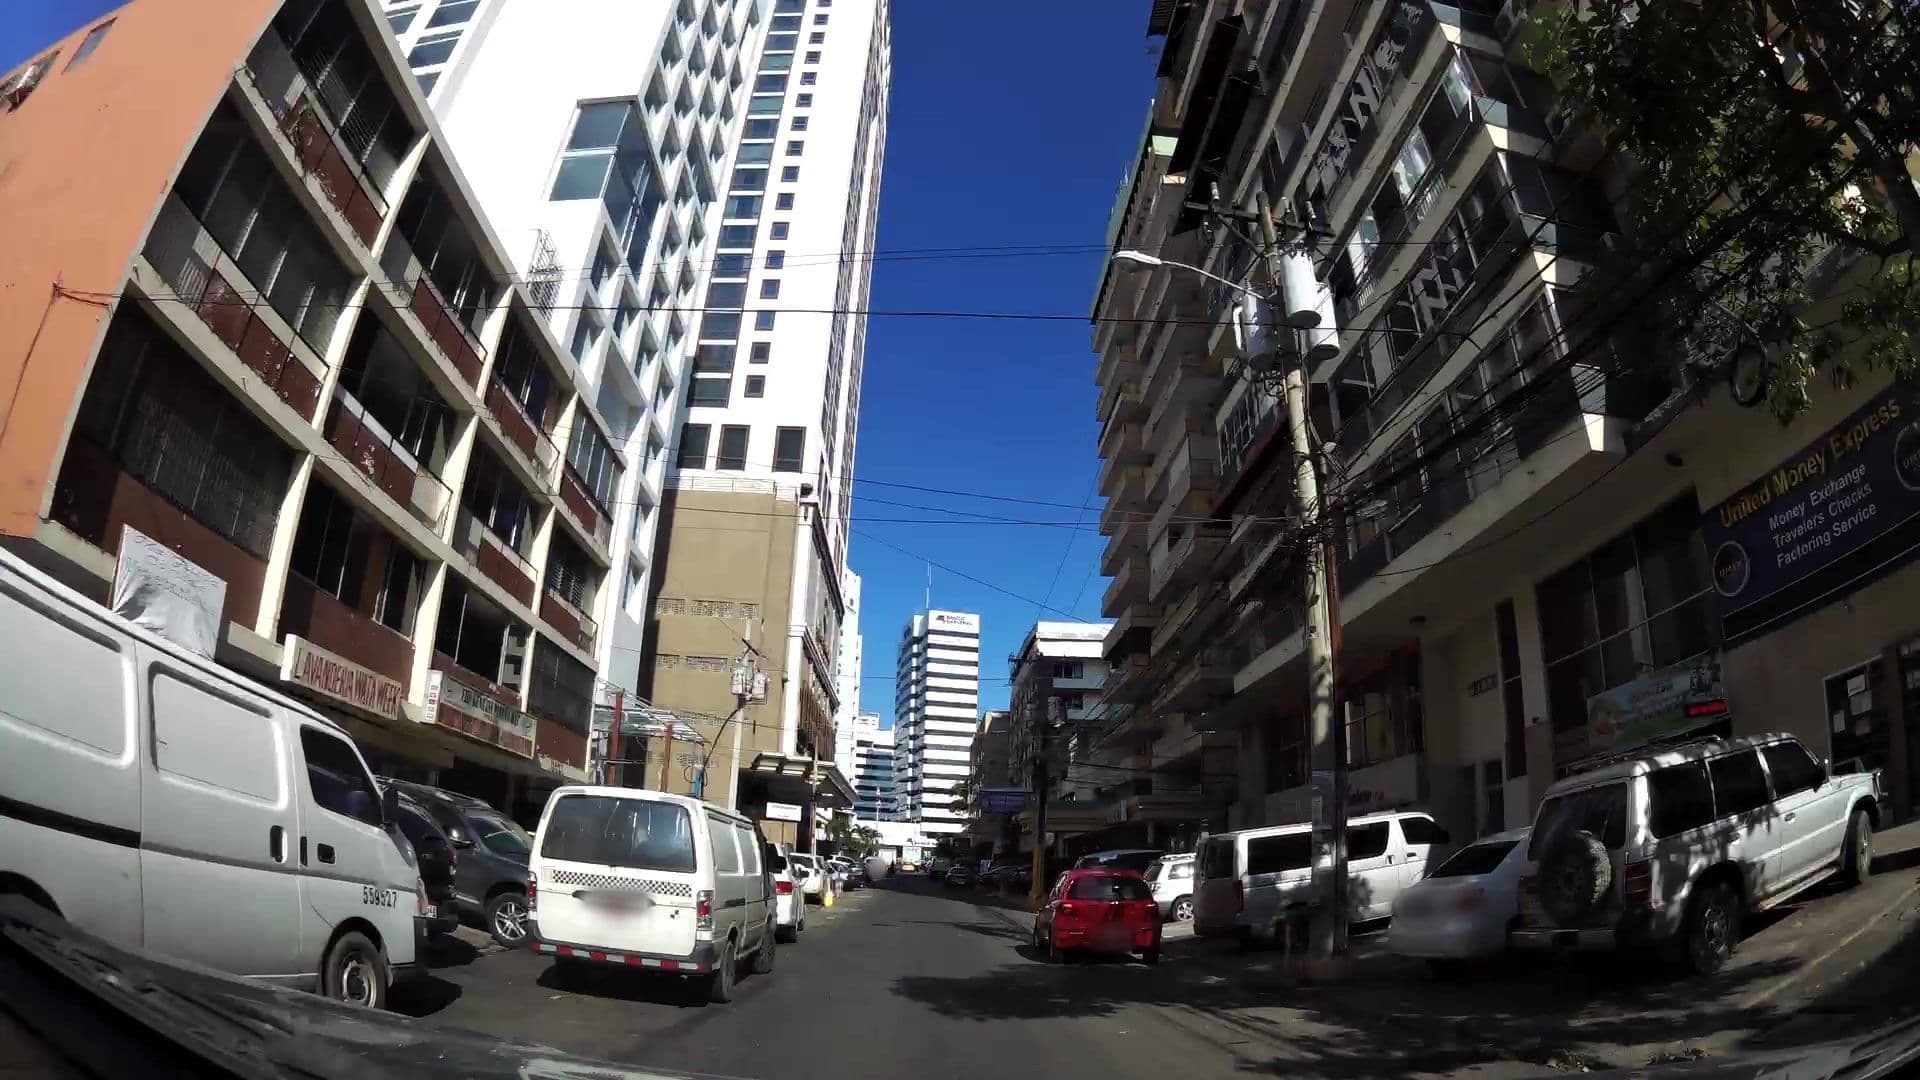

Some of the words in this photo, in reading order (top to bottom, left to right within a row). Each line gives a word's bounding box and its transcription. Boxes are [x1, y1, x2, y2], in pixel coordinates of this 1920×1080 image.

[1719, 487, 1770, 529] United
[1773, 451, 1825, 496] Money
[1830, 400, 1901, 455] Express
[1769, 502, 1805, 530] Money
[1810, 463, 1865, 506] Exchange
[1772, 513, 1825, 549] Travelers
[1777, 531, 1831, 568] Factoring
[1832, 502, 1877, 538] Service
